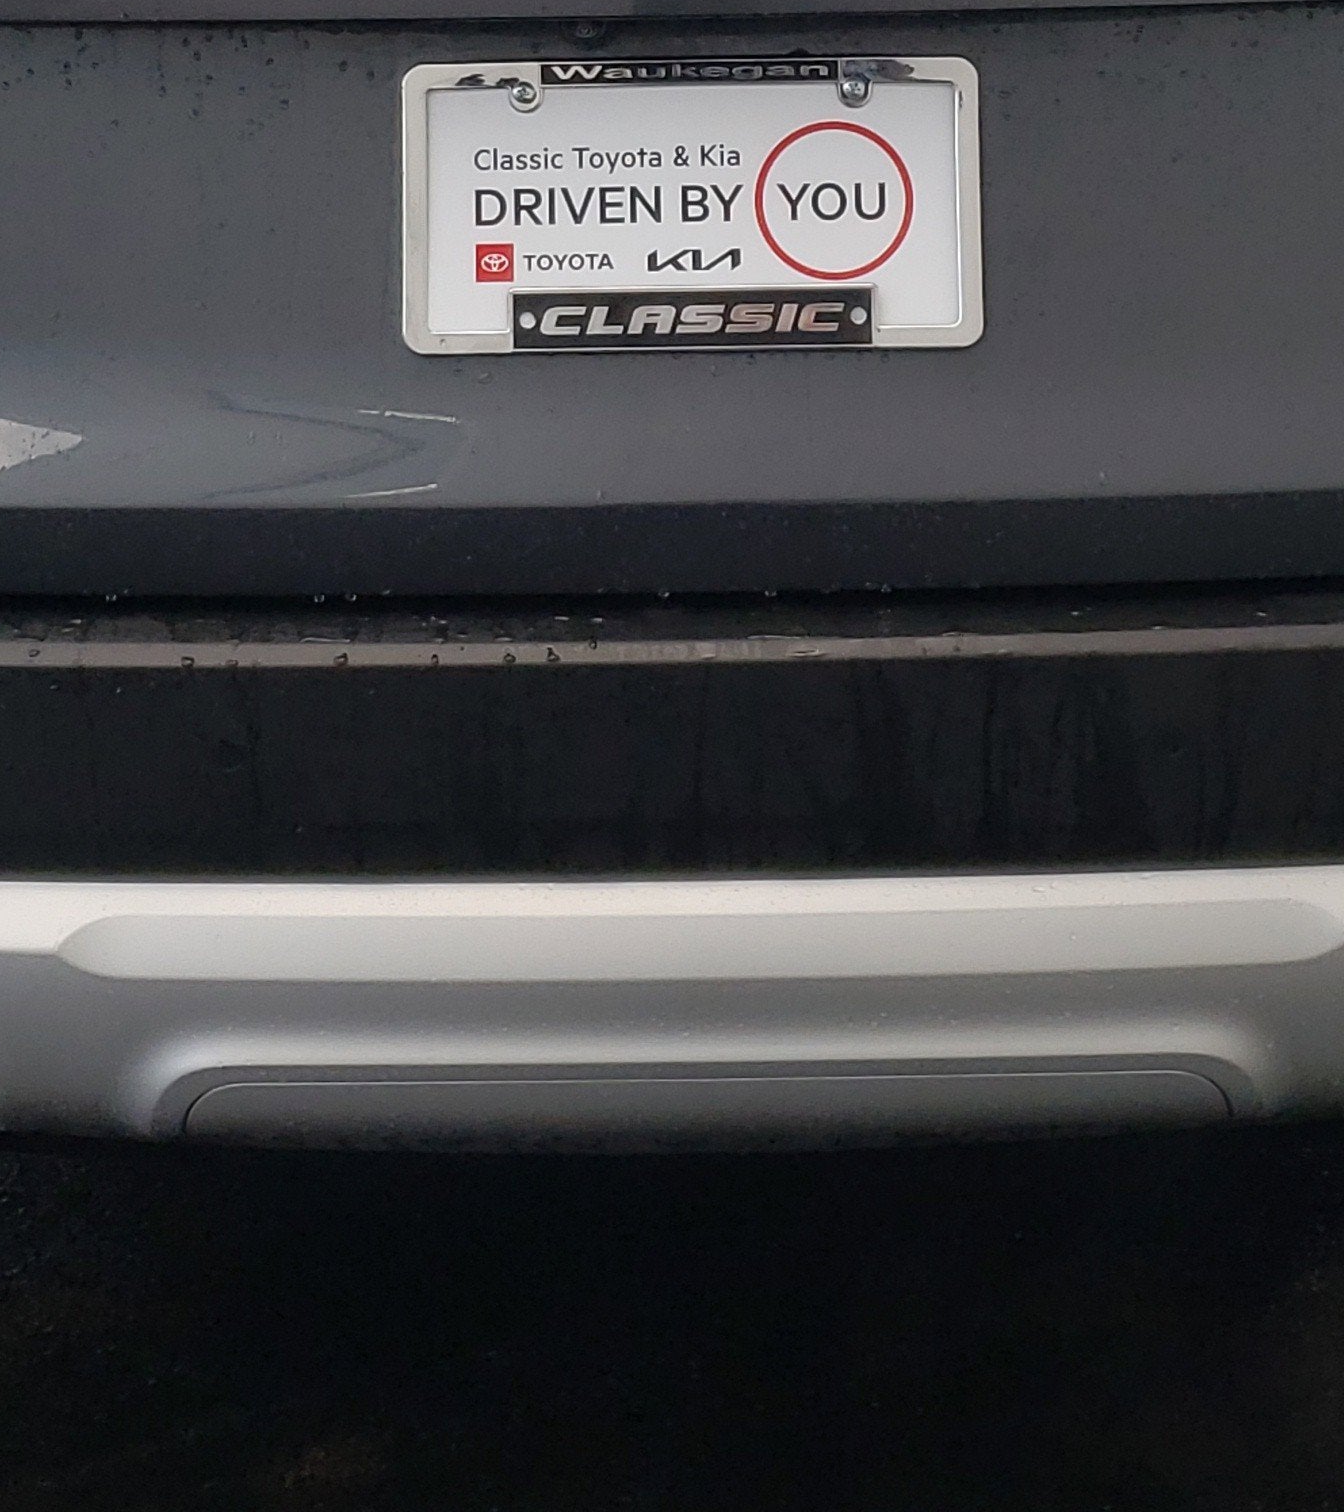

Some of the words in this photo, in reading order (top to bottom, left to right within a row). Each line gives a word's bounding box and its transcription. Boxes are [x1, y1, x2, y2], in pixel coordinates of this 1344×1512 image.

[550, 62, 830, 80] Waukegan
[473, 146, 563, 172] Classic
[572, 145, 663, 175] Toyota
[672, 146, 690, 169] &
[699, 144, 742, 168] Kia
[475, 185, 662, 226] DRIVEN
[680, 184, 744, 223] BY
[776, 181, 887, 221] YOU
[523, 252, 615, 272] TOYOTA
[538, 302, 845, 336] CLASSIC
